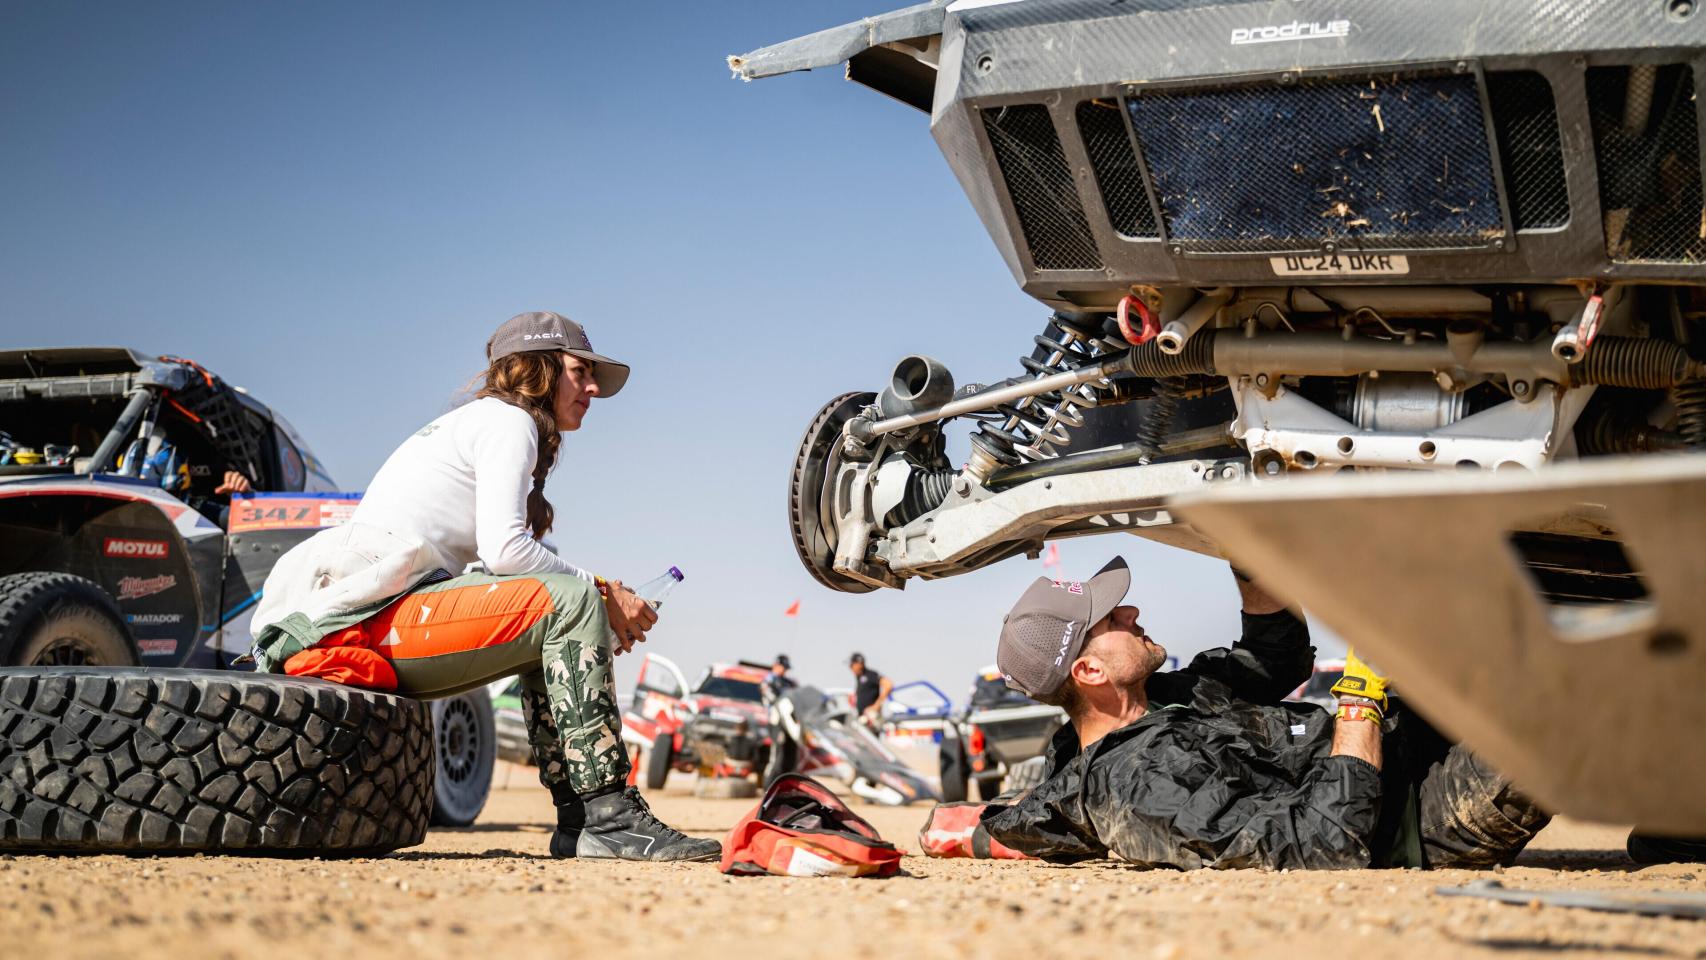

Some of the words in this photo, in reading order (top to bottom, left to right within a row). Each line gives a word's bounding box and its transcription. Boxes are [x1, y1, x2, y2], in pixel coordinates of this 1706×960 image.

[1231, 20, 1350, 45] prodrive
[1284, 255, 1342, 271] DC24
[1347, 255, 1393, 271] DKR
[524, 332, 563, 341] DACIA
[966, 385, 977, 394] FR
[242, 506, 311, 522] 347
[107, 540, 167, 556] MOTUL
[133, 614, 181, 623] MATADOR
[1054, 620, 1076, 667] DACIA
